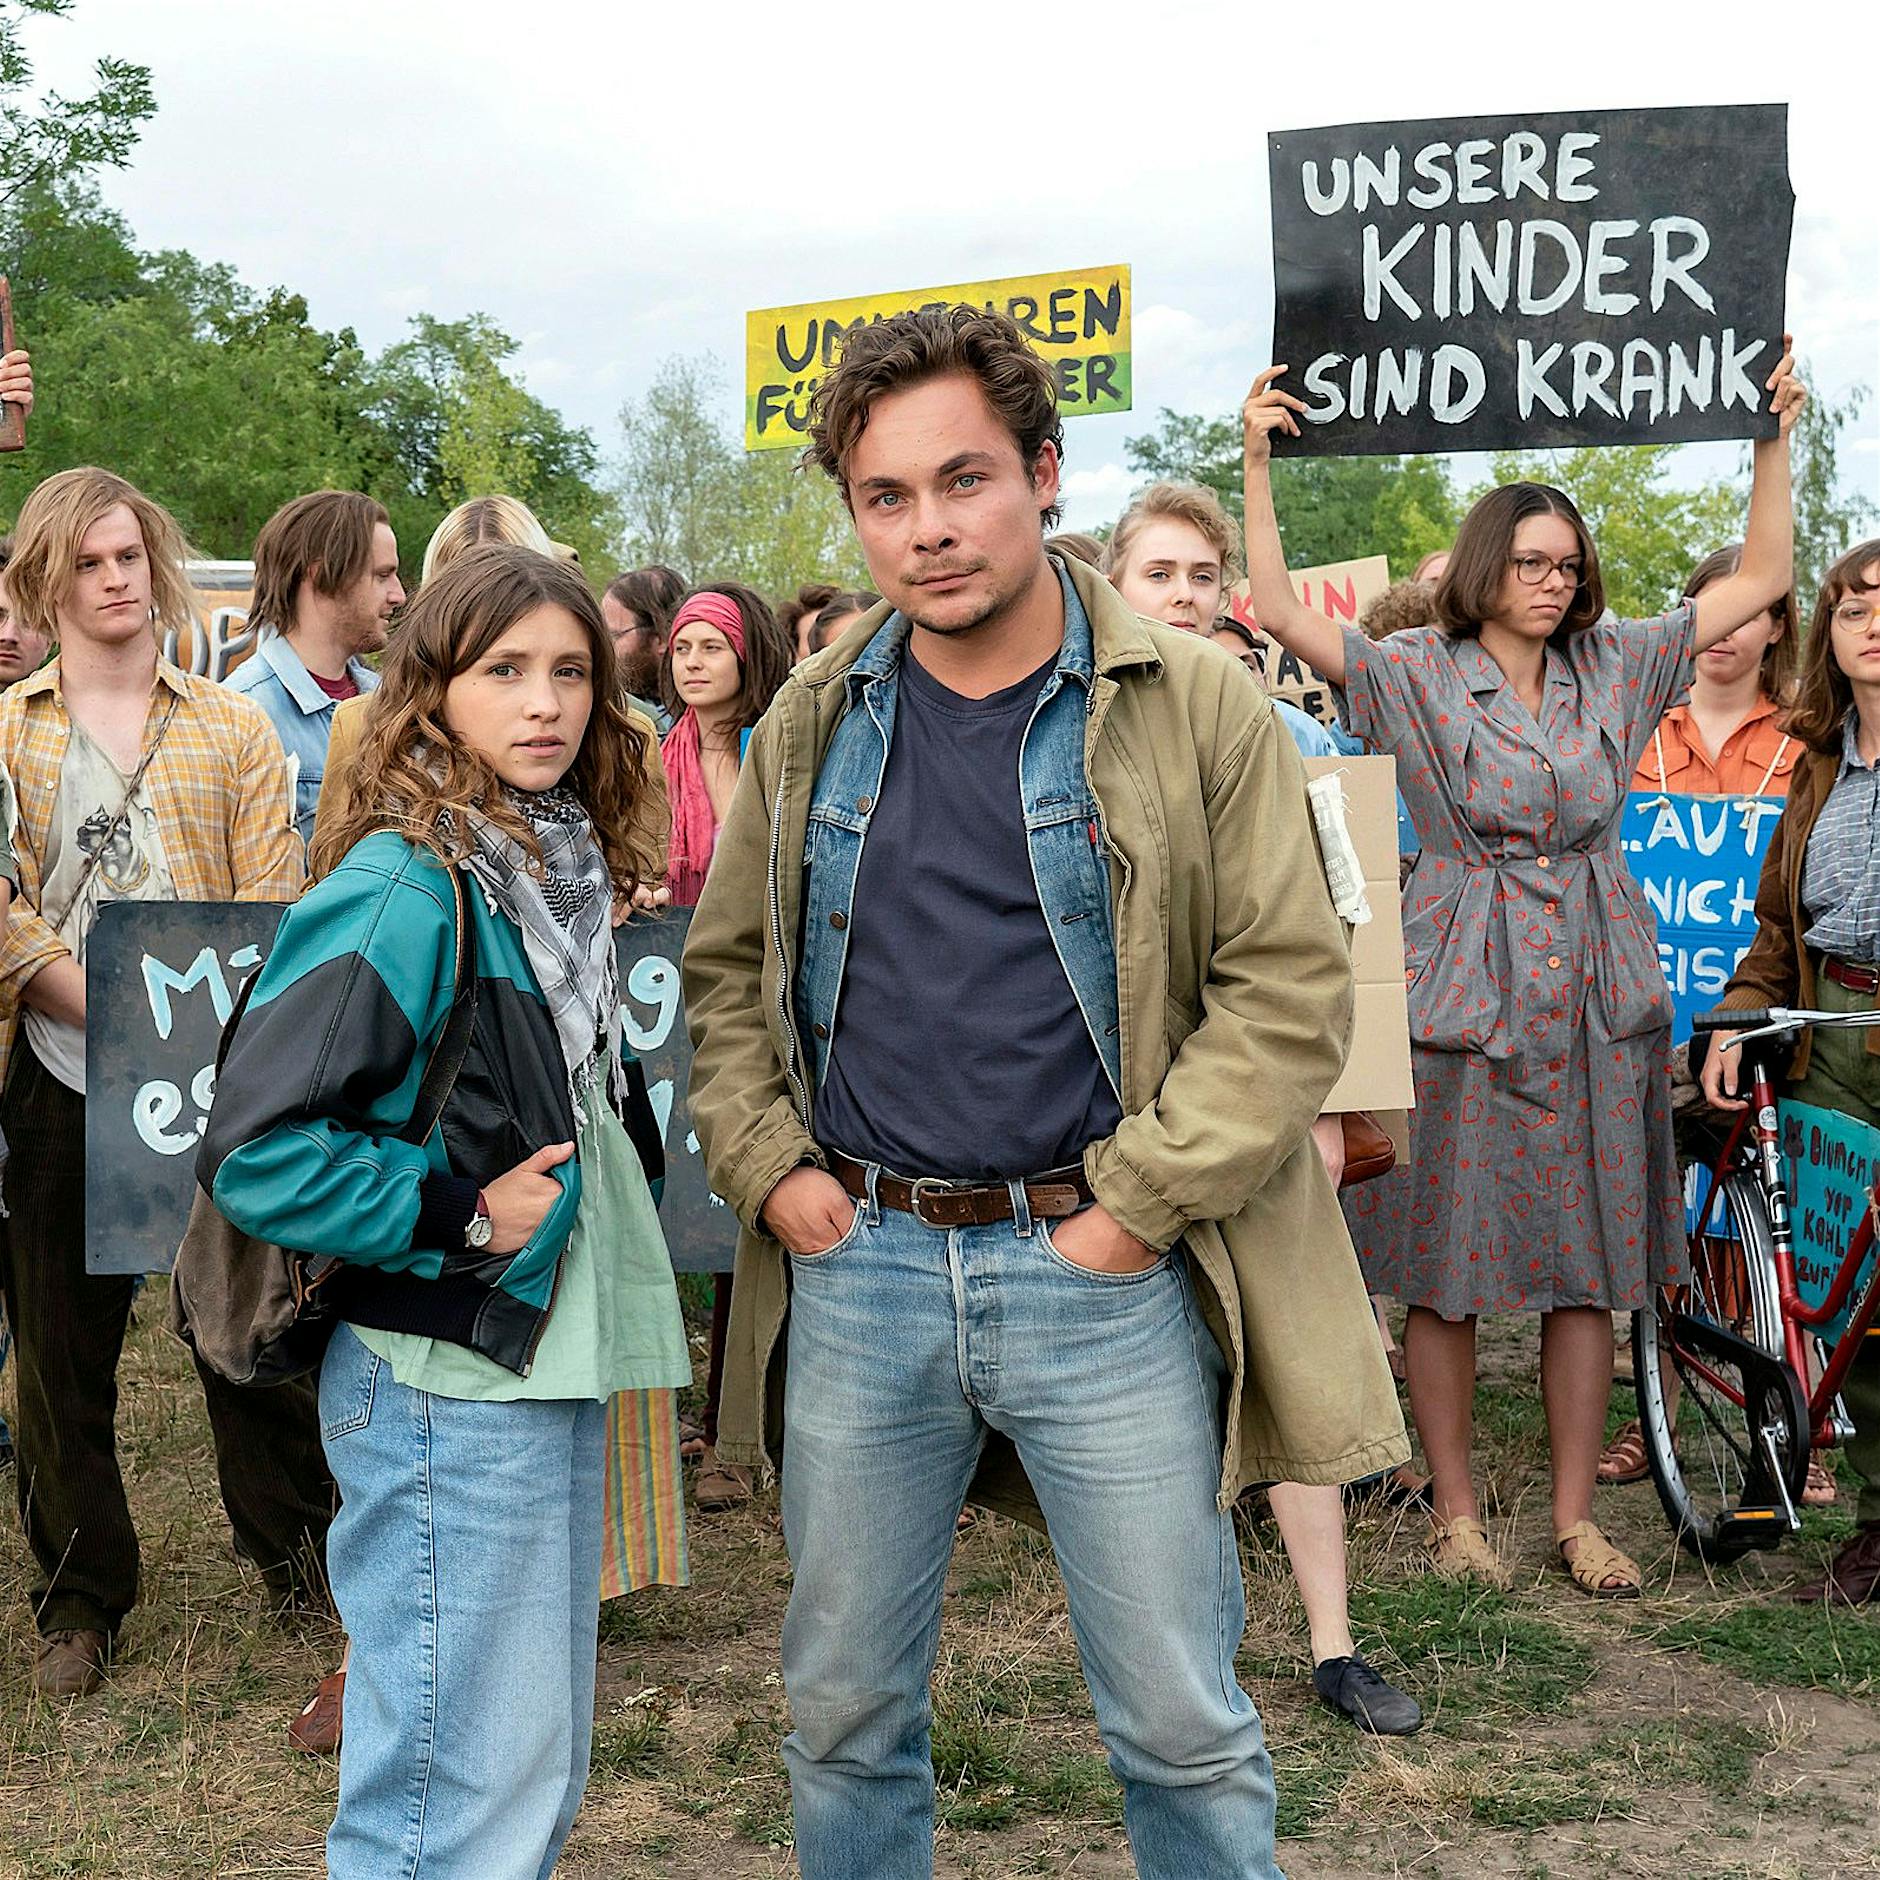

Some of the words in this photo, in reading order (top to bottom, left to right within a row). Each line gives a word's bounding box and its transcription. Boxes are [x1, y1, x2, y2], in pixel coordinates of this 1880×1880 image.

[1302, 131, 1601, 216] UNSERE
[1362, 216, 1717, 322] KINDER
[756, 378, 818, 436] FÜ
[1055, 355, 1123, 404] ER
[1303, 343, 1487, 425] SIND
[1517, 328, 1768, 425] KRANK
[1620, 801, 1784, 857] AUT
[1644, 875, 1762, 927] NICH
